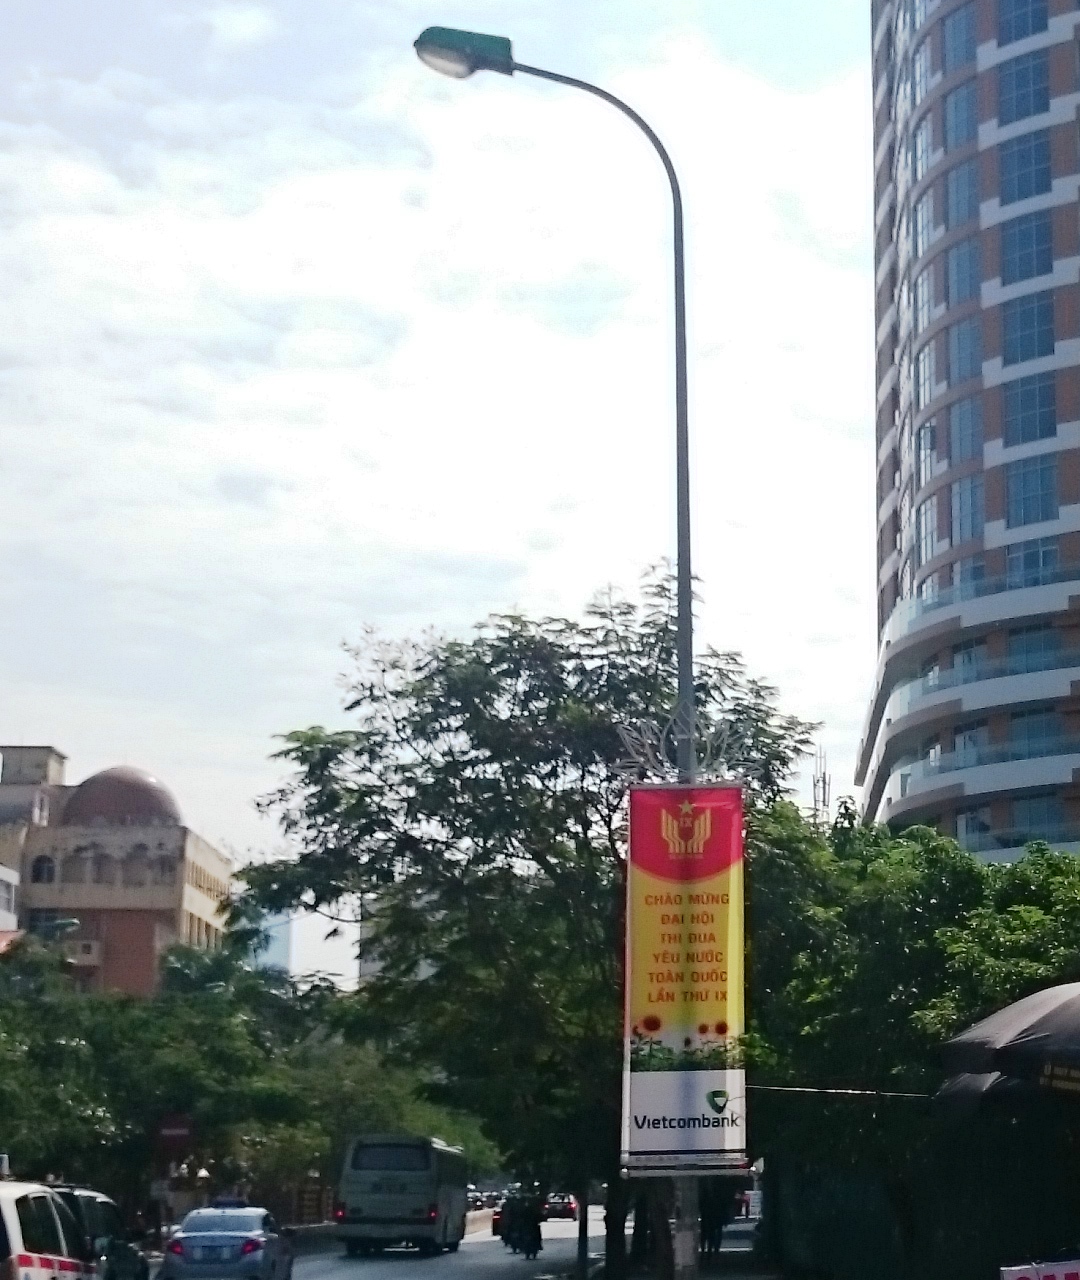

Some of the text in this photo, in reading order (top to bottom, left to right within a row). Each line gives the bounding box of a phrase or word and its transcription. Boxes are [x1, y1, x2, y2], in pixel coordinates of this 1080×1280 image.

[645, 891, 730, 906] CHÀO MỪNG
[660, 933, 716, 944] THI ĐUA
[653, 950, 679, 964] YÊU
[648, 967, 728, 983] TOÀN QUỐC
[715, 990, 728, 1002] IX
[633, 1113, 739, 1130] Vietcombank
